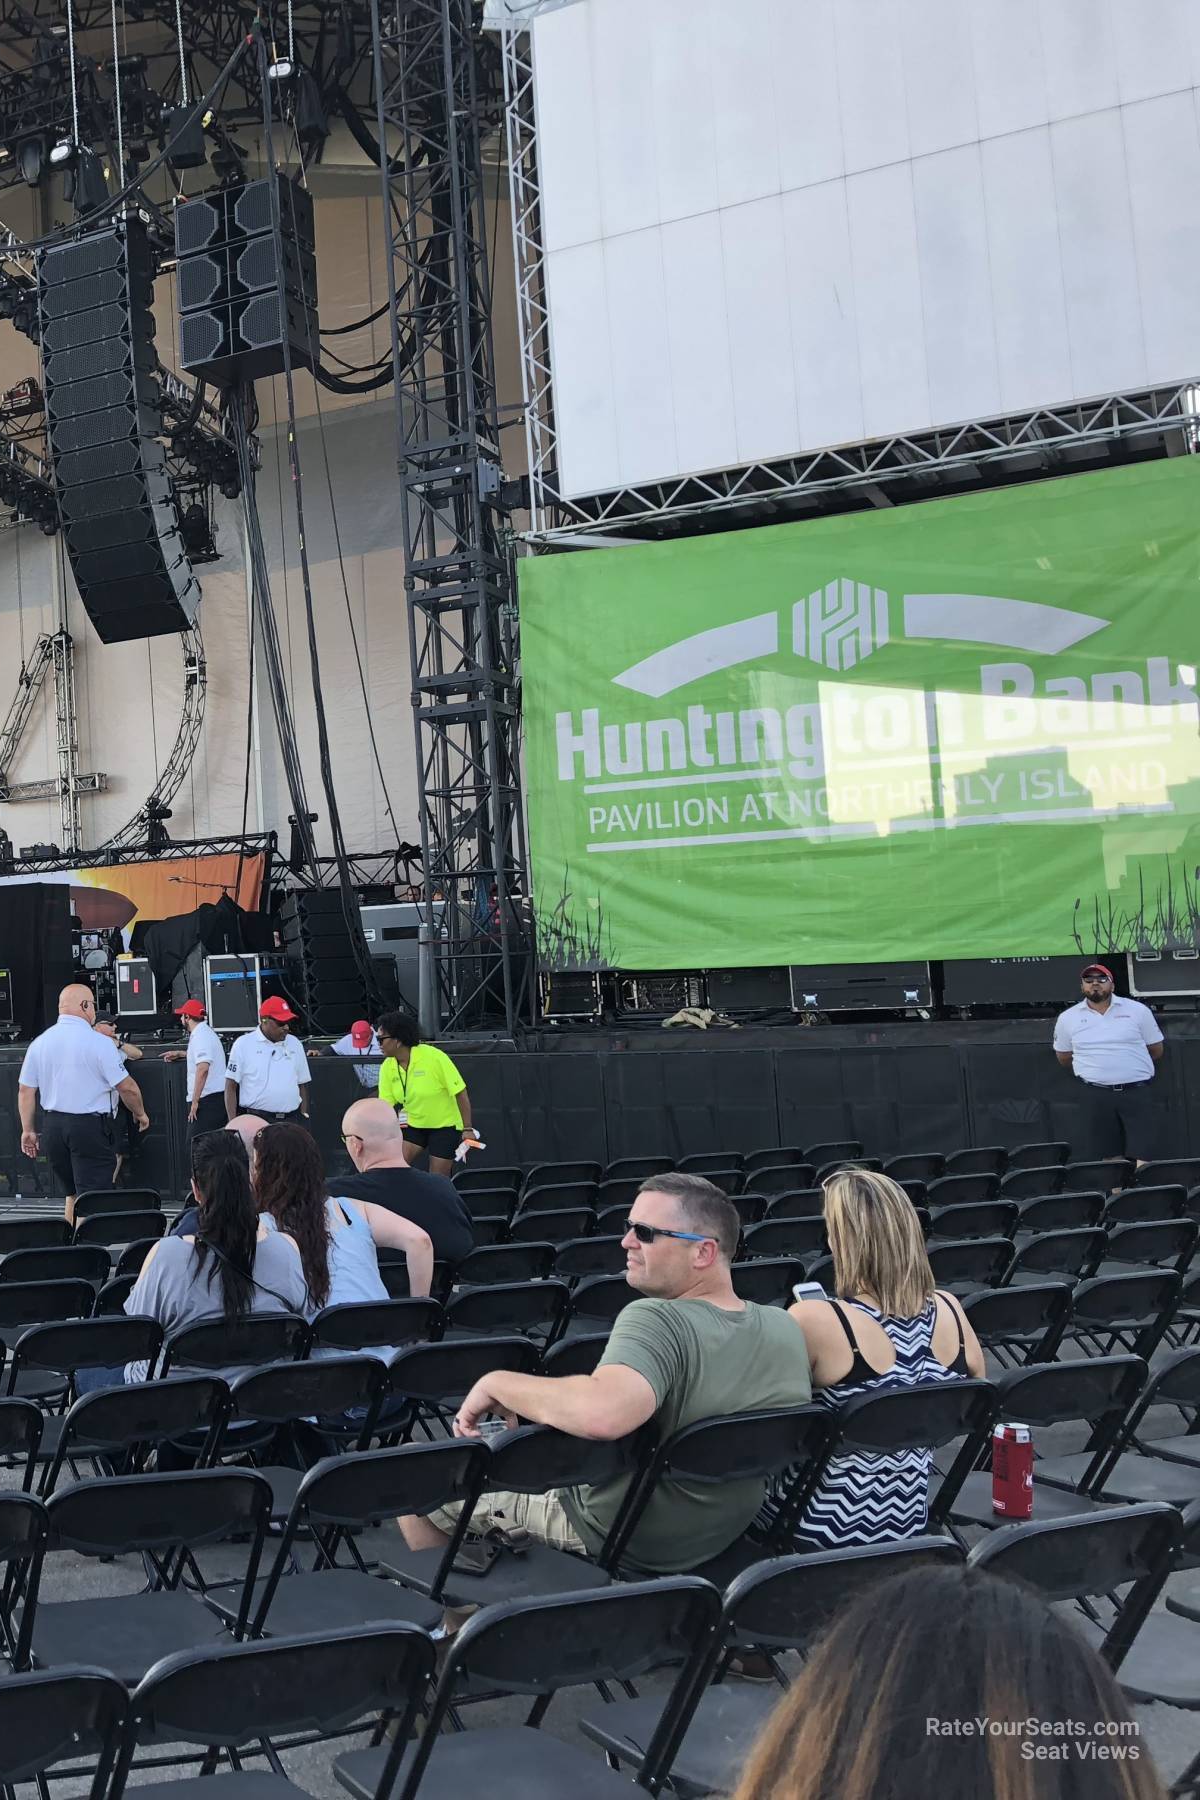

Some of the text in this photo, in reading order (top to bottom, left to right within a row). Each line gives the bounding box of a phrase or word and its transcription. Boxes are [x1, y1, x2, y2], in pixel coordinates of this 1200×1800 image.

[556, 656, 1199, 781] Huntington Bank
[588, 760, 1167, 834] PAVILION AT NORTHERLY ISLAND
